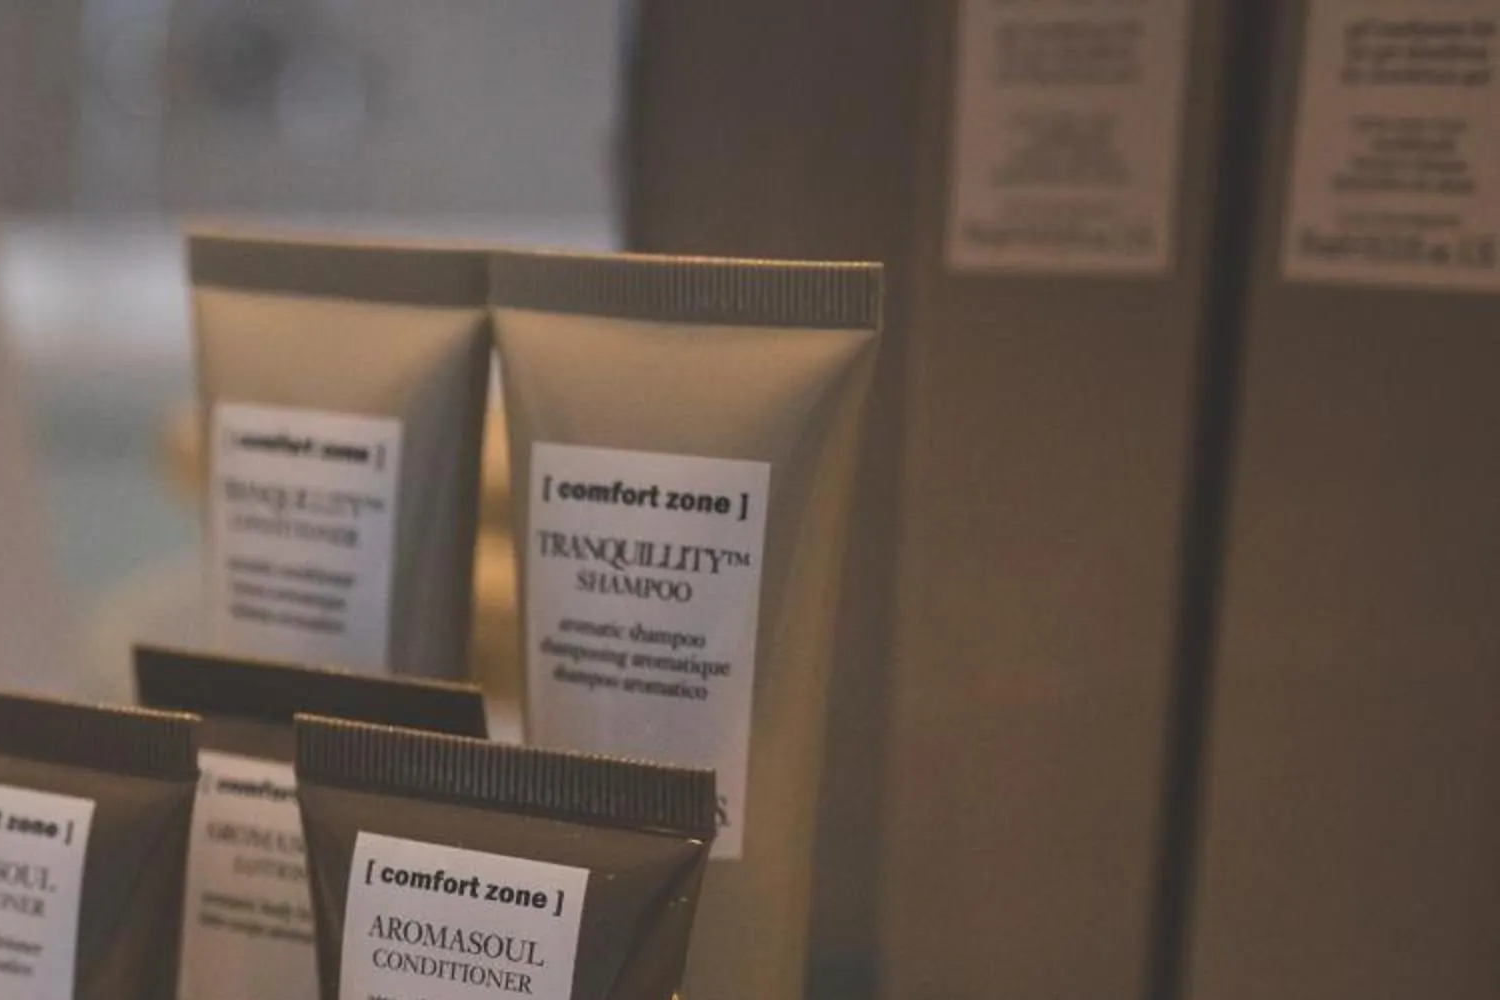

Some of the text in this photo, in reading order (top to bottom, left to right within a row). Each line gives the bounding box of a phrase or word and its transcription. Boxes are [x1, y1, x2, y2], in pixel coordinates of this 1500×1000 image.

[558, 478, 659, 508] comfort
[665, 491, 731, 516] zone
[576, 568, 693, 602] SHAMPOO
[629, 623, 706, 651] shampoo
[631, 653, 731, 682] aromatique
[381, 866, 480, 898] comfort
[485, 885, 549, 909] zone
[368, 915, 546, 967] AROMASOUL
[372, 948, 533, 994] CONDITIONER
